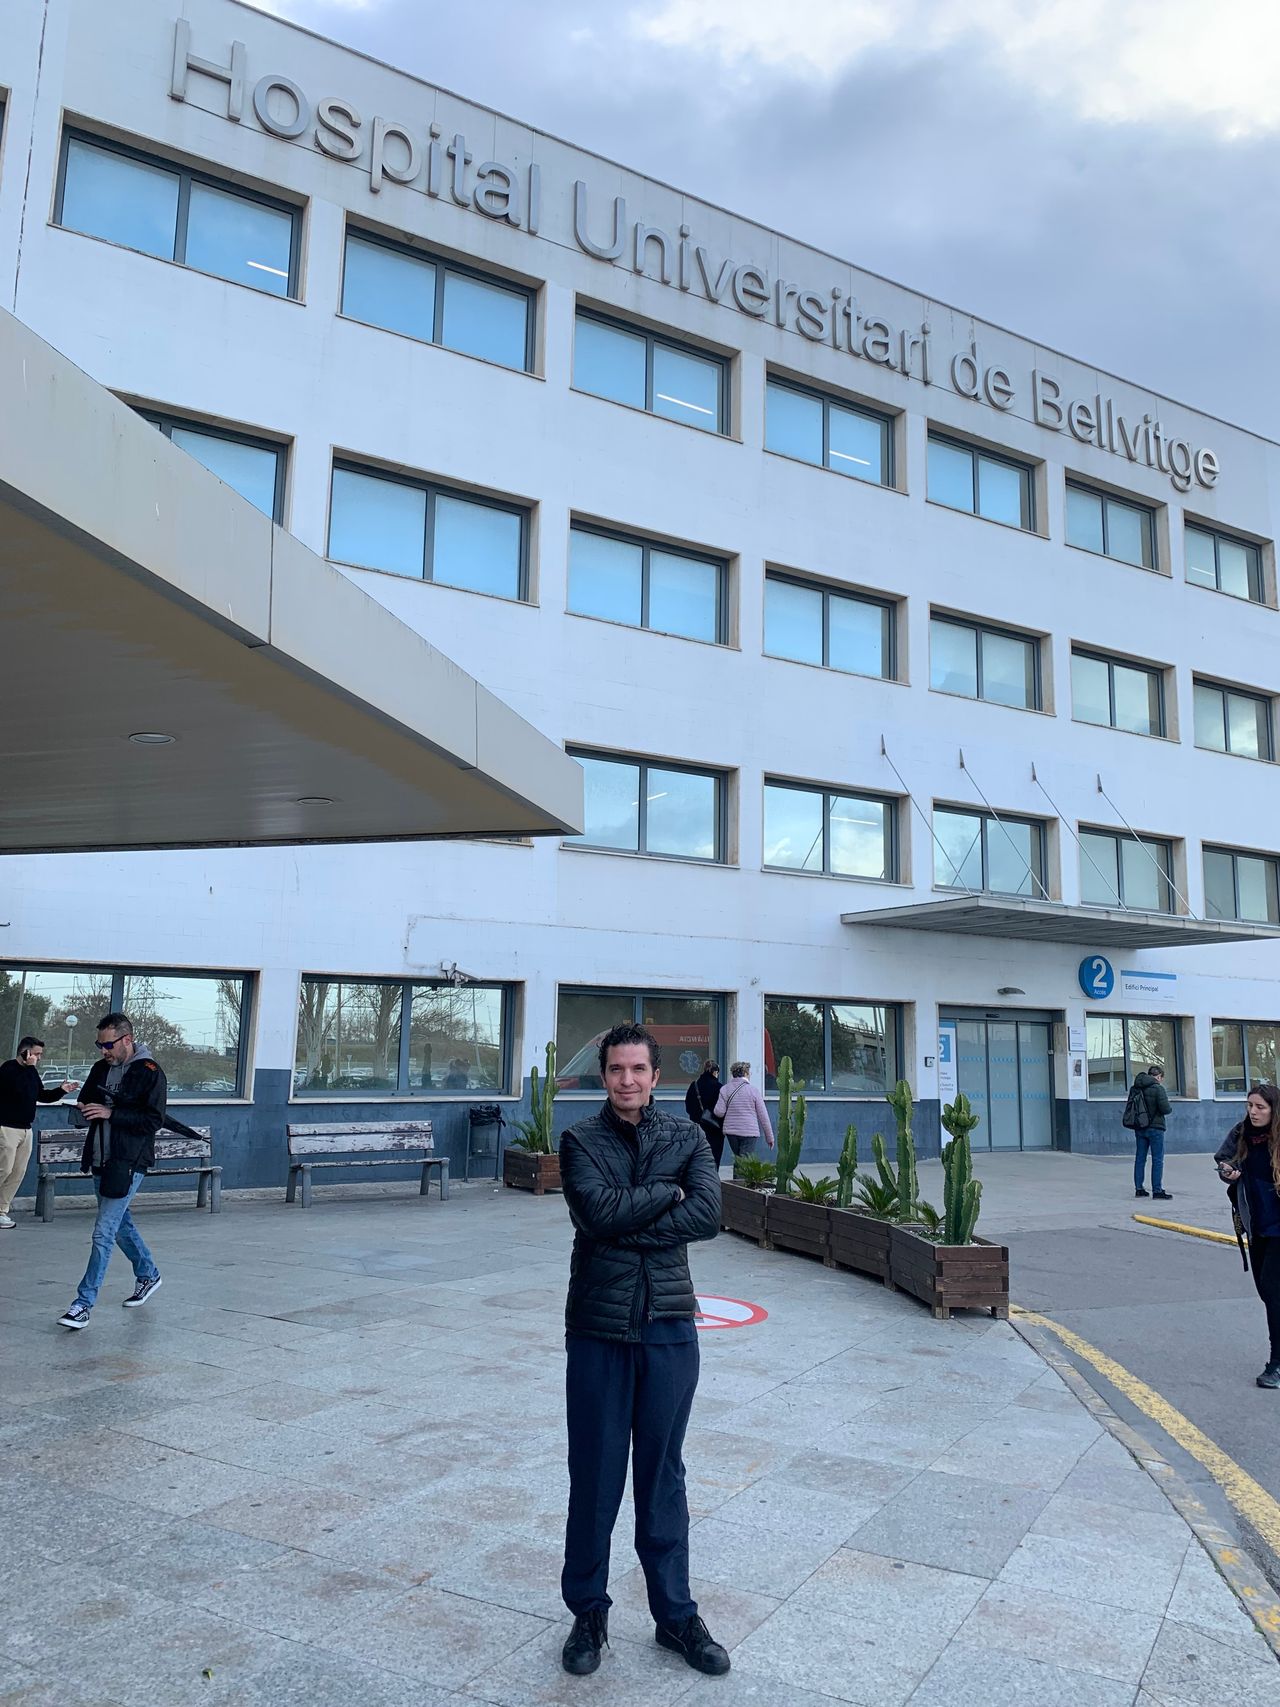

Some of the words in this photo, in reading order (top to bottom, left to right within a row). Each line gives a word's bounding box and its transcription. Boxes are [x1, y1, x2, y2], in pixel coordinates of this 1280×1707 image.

[169, 17, 541, 236] Hospital
[573, 179, 932, 385] Universitari
[951, 340, 1016, 411] de
[1032, 368, 1221, 493] Bellvitge
[1092, 959, 1107, 988] 2
[1125, 983, 1139, 991] Edifici
[1140, 984, 1159, 993] Principal
